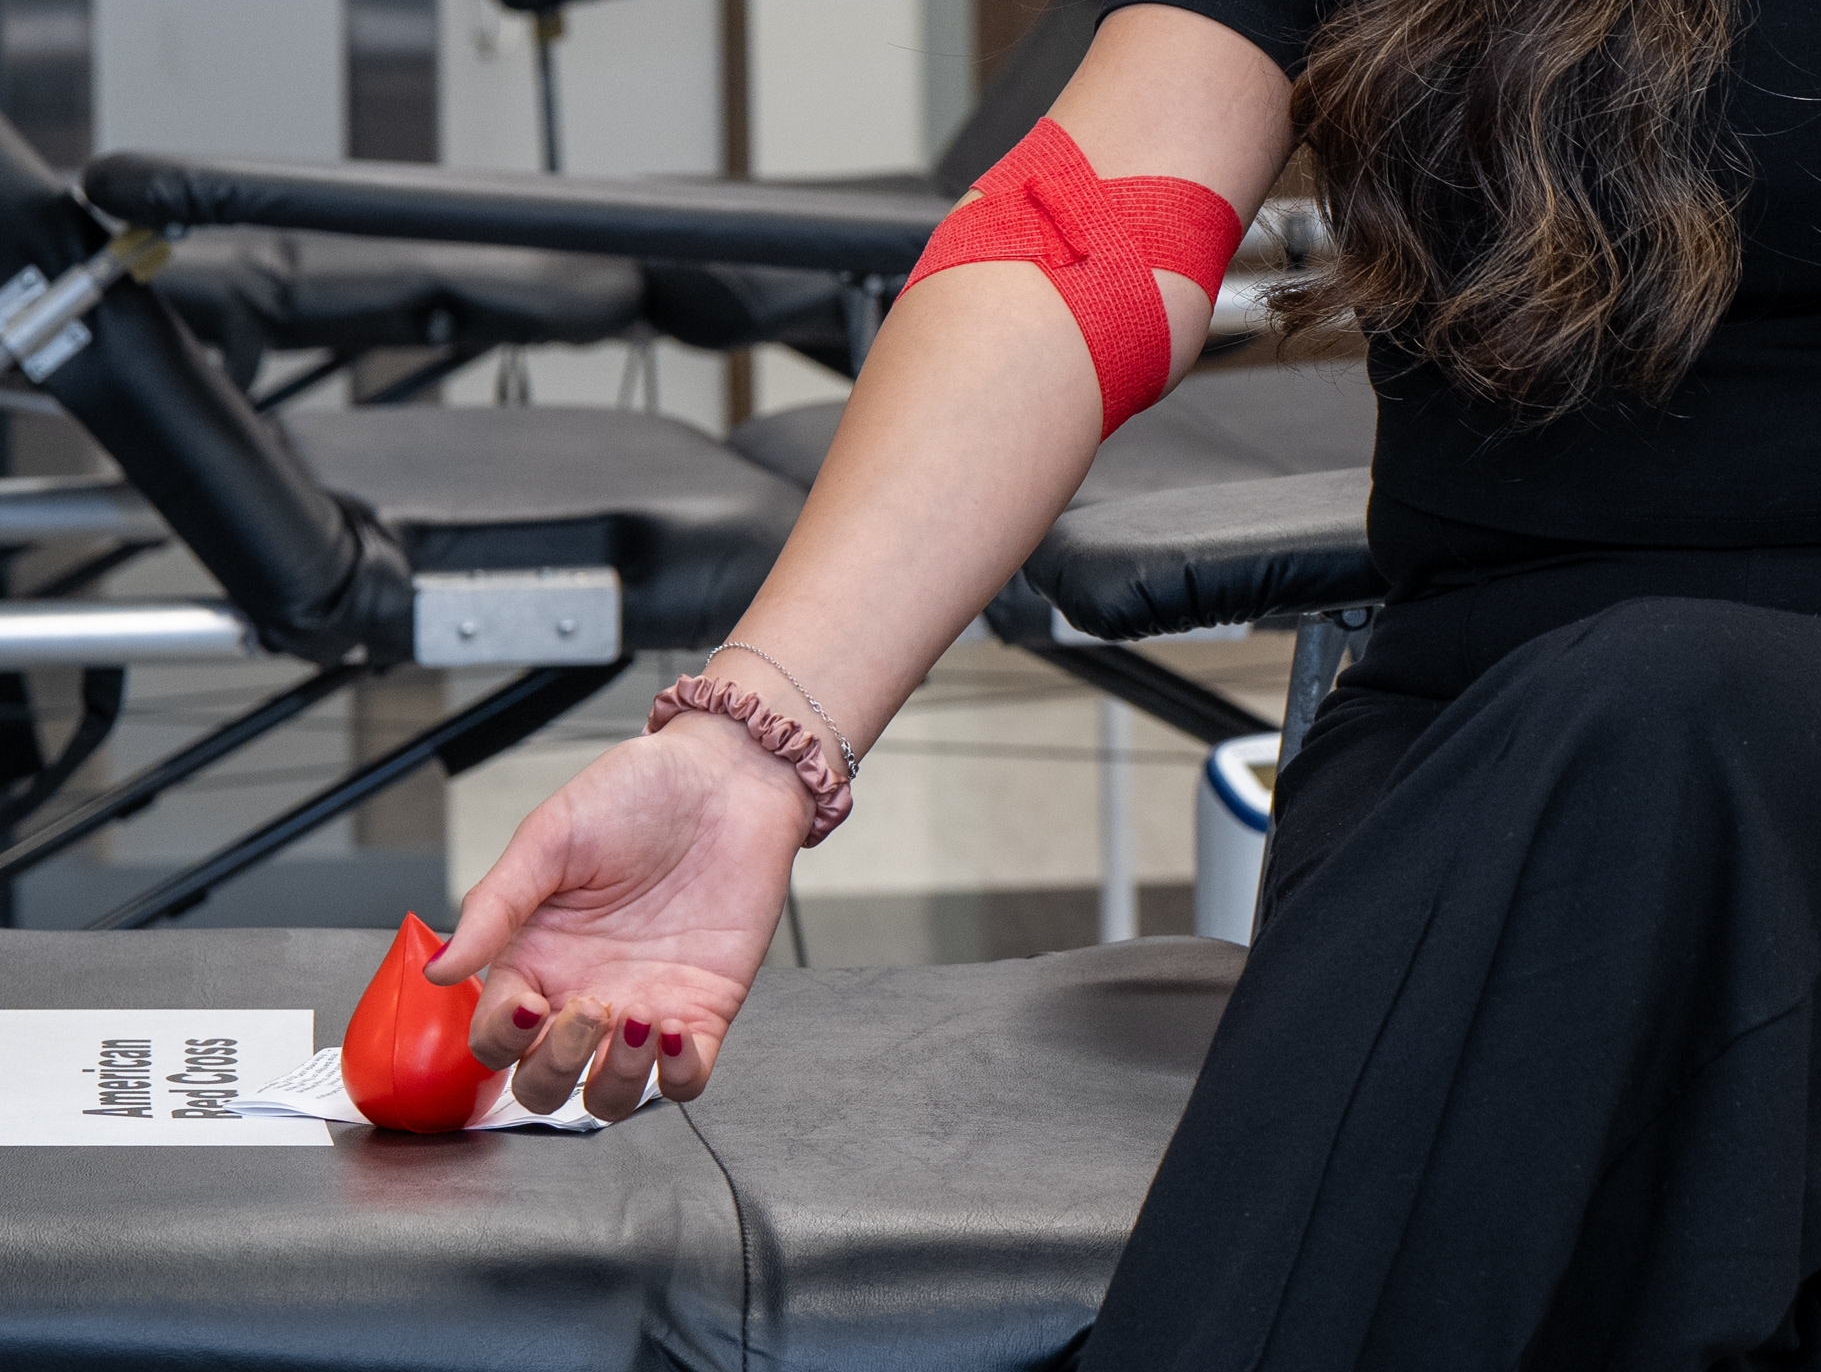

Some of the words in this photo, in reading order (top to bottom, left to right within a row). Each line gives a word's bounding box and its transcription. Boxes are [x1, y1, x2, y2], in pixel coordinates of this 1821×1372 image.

[82, 1039, 153, 1119] American
[165, 1038, 239, 1085] Cross
[168, 1089, 243, 1119] Red
